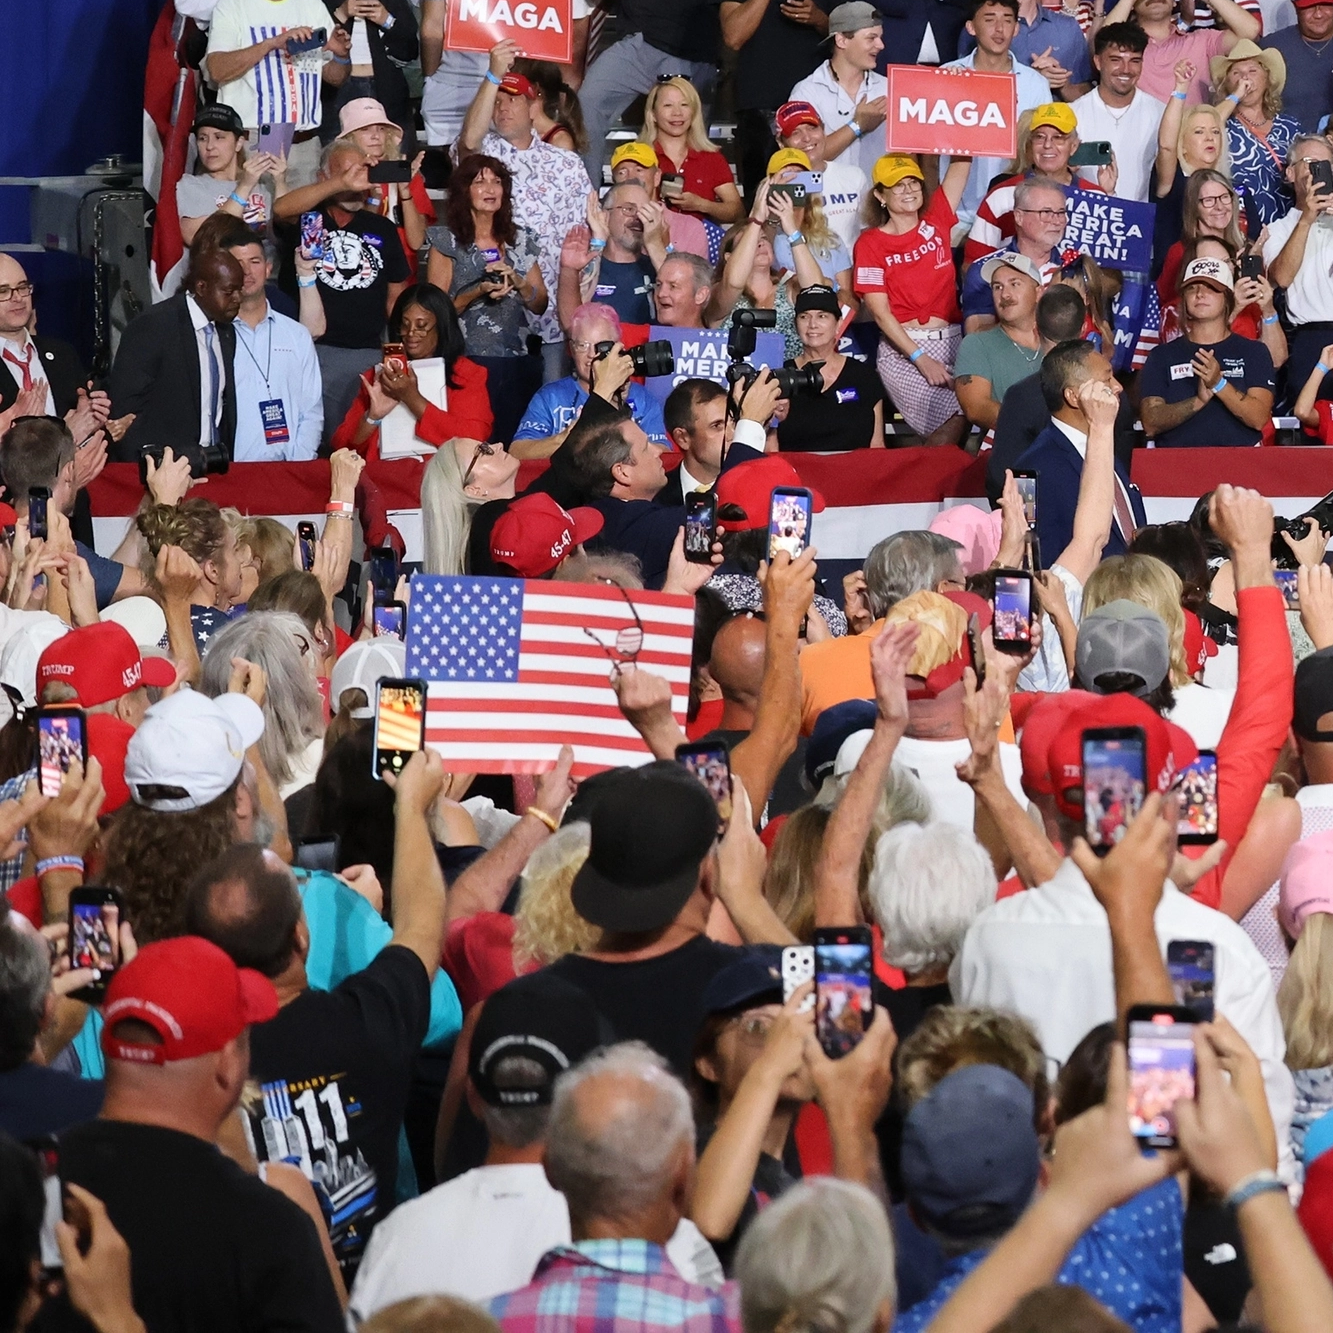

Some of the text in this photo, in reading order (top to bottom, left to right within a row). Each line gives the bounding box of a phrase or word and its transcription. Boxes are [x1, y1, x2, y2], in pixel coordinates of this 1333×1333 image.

[899, 96, 1007, 129] MAGA
[1065, 224, 1127, 249] REAT
[1066, 212, 1143, 239] ERICA
[1173, 366, 1190, 375] FRY
[494, 550, 515, 558] TRUMP
[550, 528, 573, 558] 45-47
[42, 666, 75, 676] TRUMP
